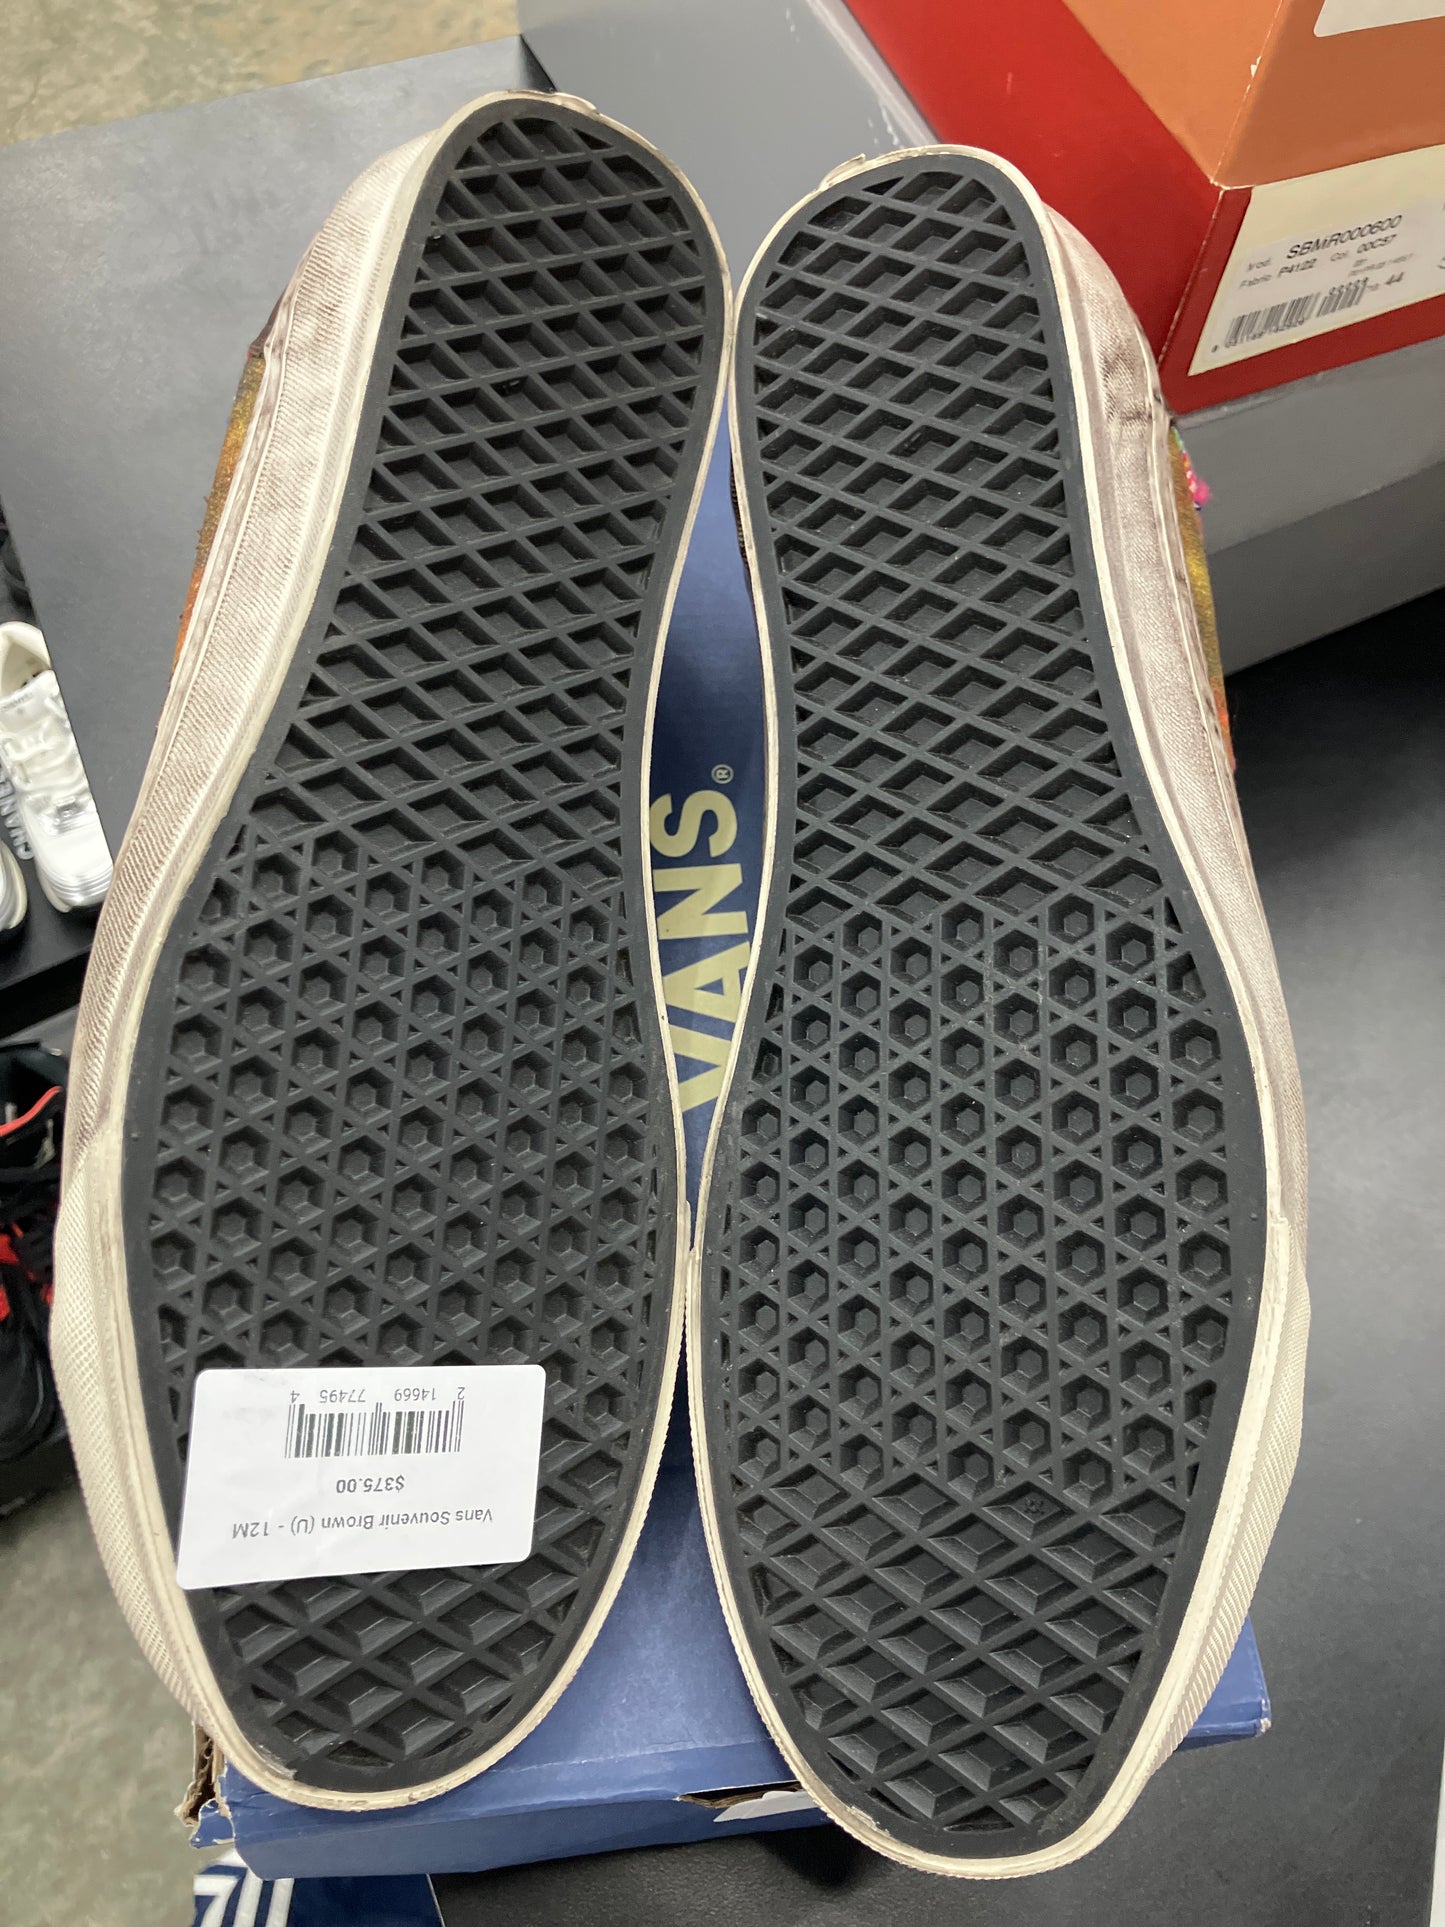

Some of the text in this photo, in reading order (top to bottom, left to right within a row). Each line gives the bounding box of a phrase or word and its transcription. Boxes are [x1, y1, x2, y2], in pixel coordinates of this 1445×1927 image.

[0, 774, 35, 861] CHANE
[650, 789, 751, 1113] VANS
[290, 1386, 466, 1404] 2 14669 77495 4
[335, 1474, 406, 1494] $375.00
[290, 1514, 315, 1537] (U)
[321, 1514, 375, 1530] Brown
[378, 1510, 451, 1530] Souvenir
[455, 1508, 493, 1523] Vans
[231, 1520, 269, 1540] 12M
